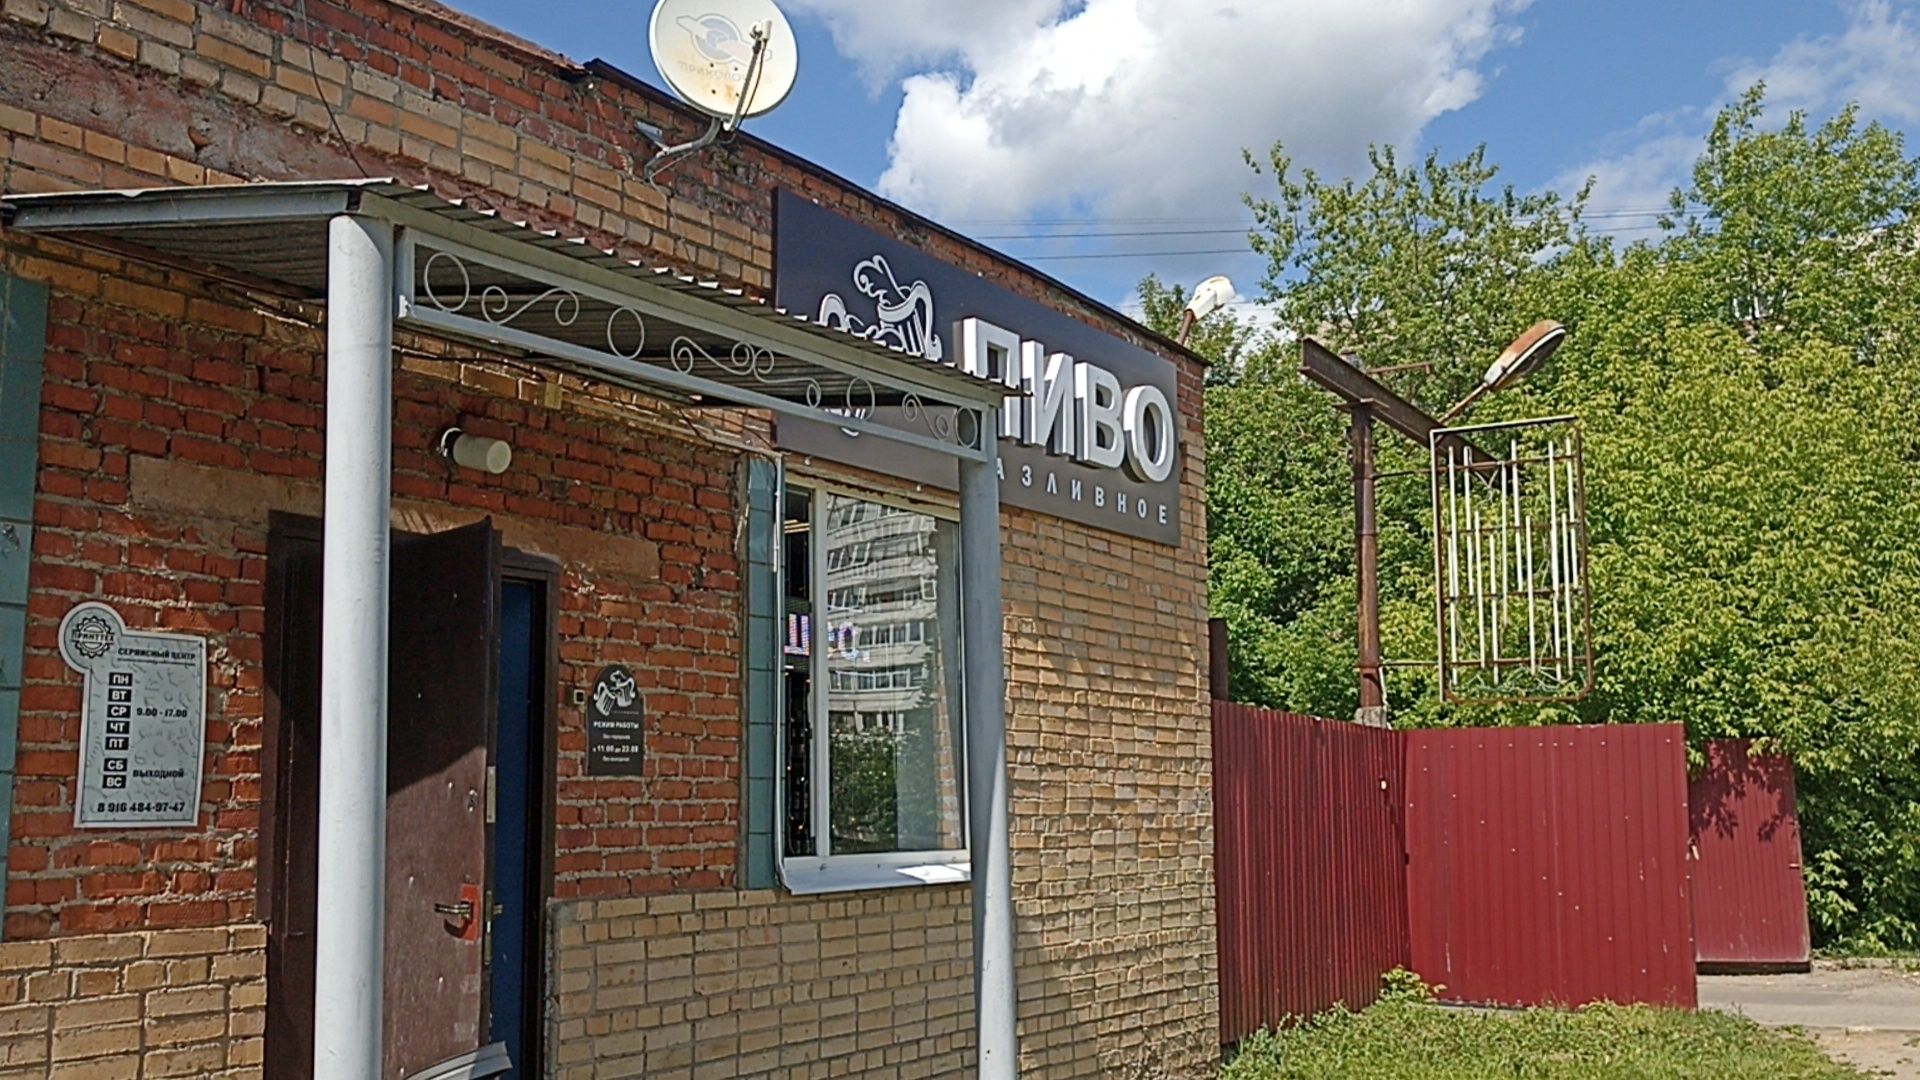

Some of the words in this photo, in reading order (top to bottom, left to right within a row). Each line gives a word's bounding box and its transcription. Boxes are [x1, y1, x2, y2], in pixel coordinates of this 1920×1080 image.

[953, 317, 1175, 483] ПИВО
[997, 457, 1167, 525] АЗЛИВНОЕ
[112, 674, 129, 684] ПН
[112, 690, 127, 700] ВТ
[110, 706, 127, 716] СР
[136, 708, 157, 717] 9.00
[110, 723, 125, 732] ЧТ
[108, 739, 124, 748] ПТ
[107, 760, 124, 770] СБ
[132, 768, 184, 779] ВЫХОДНОЙ
[106, 777, 122, 787] ВС
[97, 802, 105, 813] 8
[107, 802, 127, 813] 916
[129, 801, 185, 813] 484-97-47
